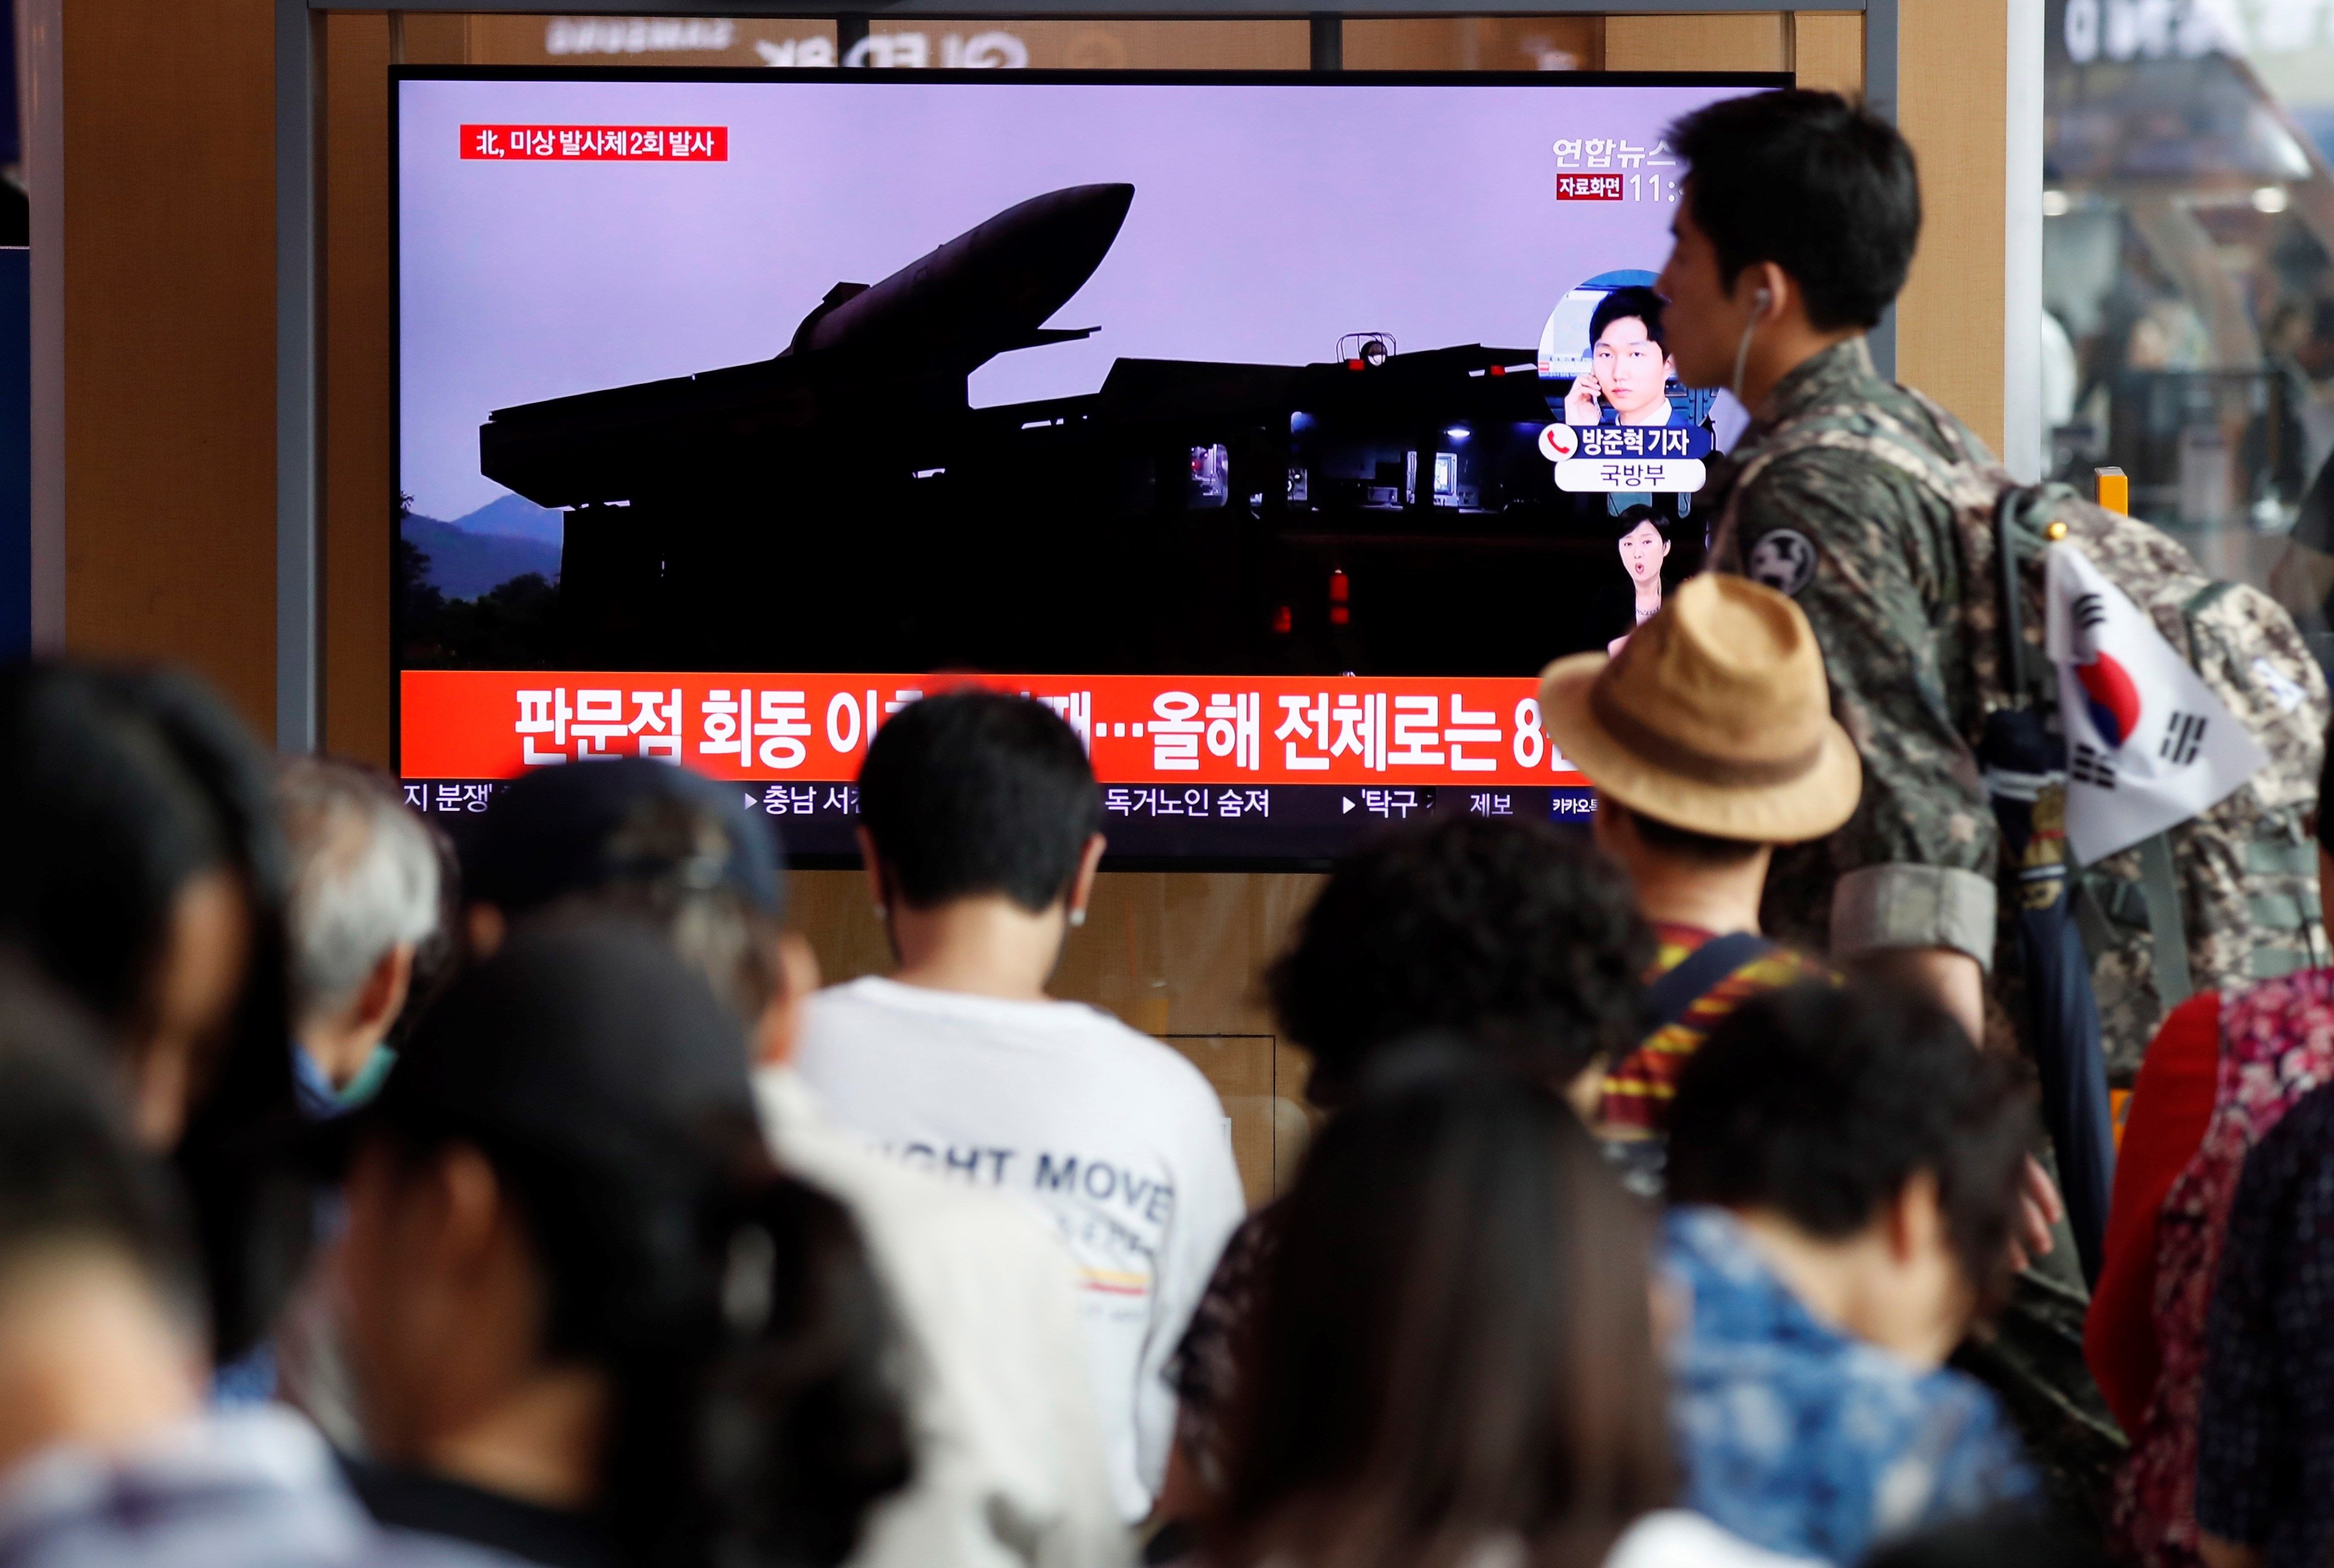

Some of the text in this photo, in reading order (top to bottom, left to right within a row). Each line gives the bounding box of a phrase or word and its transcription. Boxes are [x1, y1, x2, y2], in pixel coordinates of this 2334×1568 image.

[476, 130, 505, 158] 北,
[510, 130, 556, 157] 미상
[669, 131, 715, 157] 발사
[1553, 138, 1677, 169] 연합뉴스
[1559, 174, 1684, 202] 자료화면 11:
[1582, 428, 1690, 456] 방준혁 기자
[1600, 464, 1666, 487] 국방부
[515, 687, 682, 767] 판문점
[699, 688, 811, 769] 회동
[826, 689, 923, 753] 이
[1274, 692, 1502, 772] 전체로는
[763, 785, 817, 815] 충남
[1105, 788, 1209, 817] 독거노인
[1217, 788, 1270, 818] 숨져
[1470, 793, 1514, 818] 제보
[1033, 1149, 1175, 1225] MOVE
